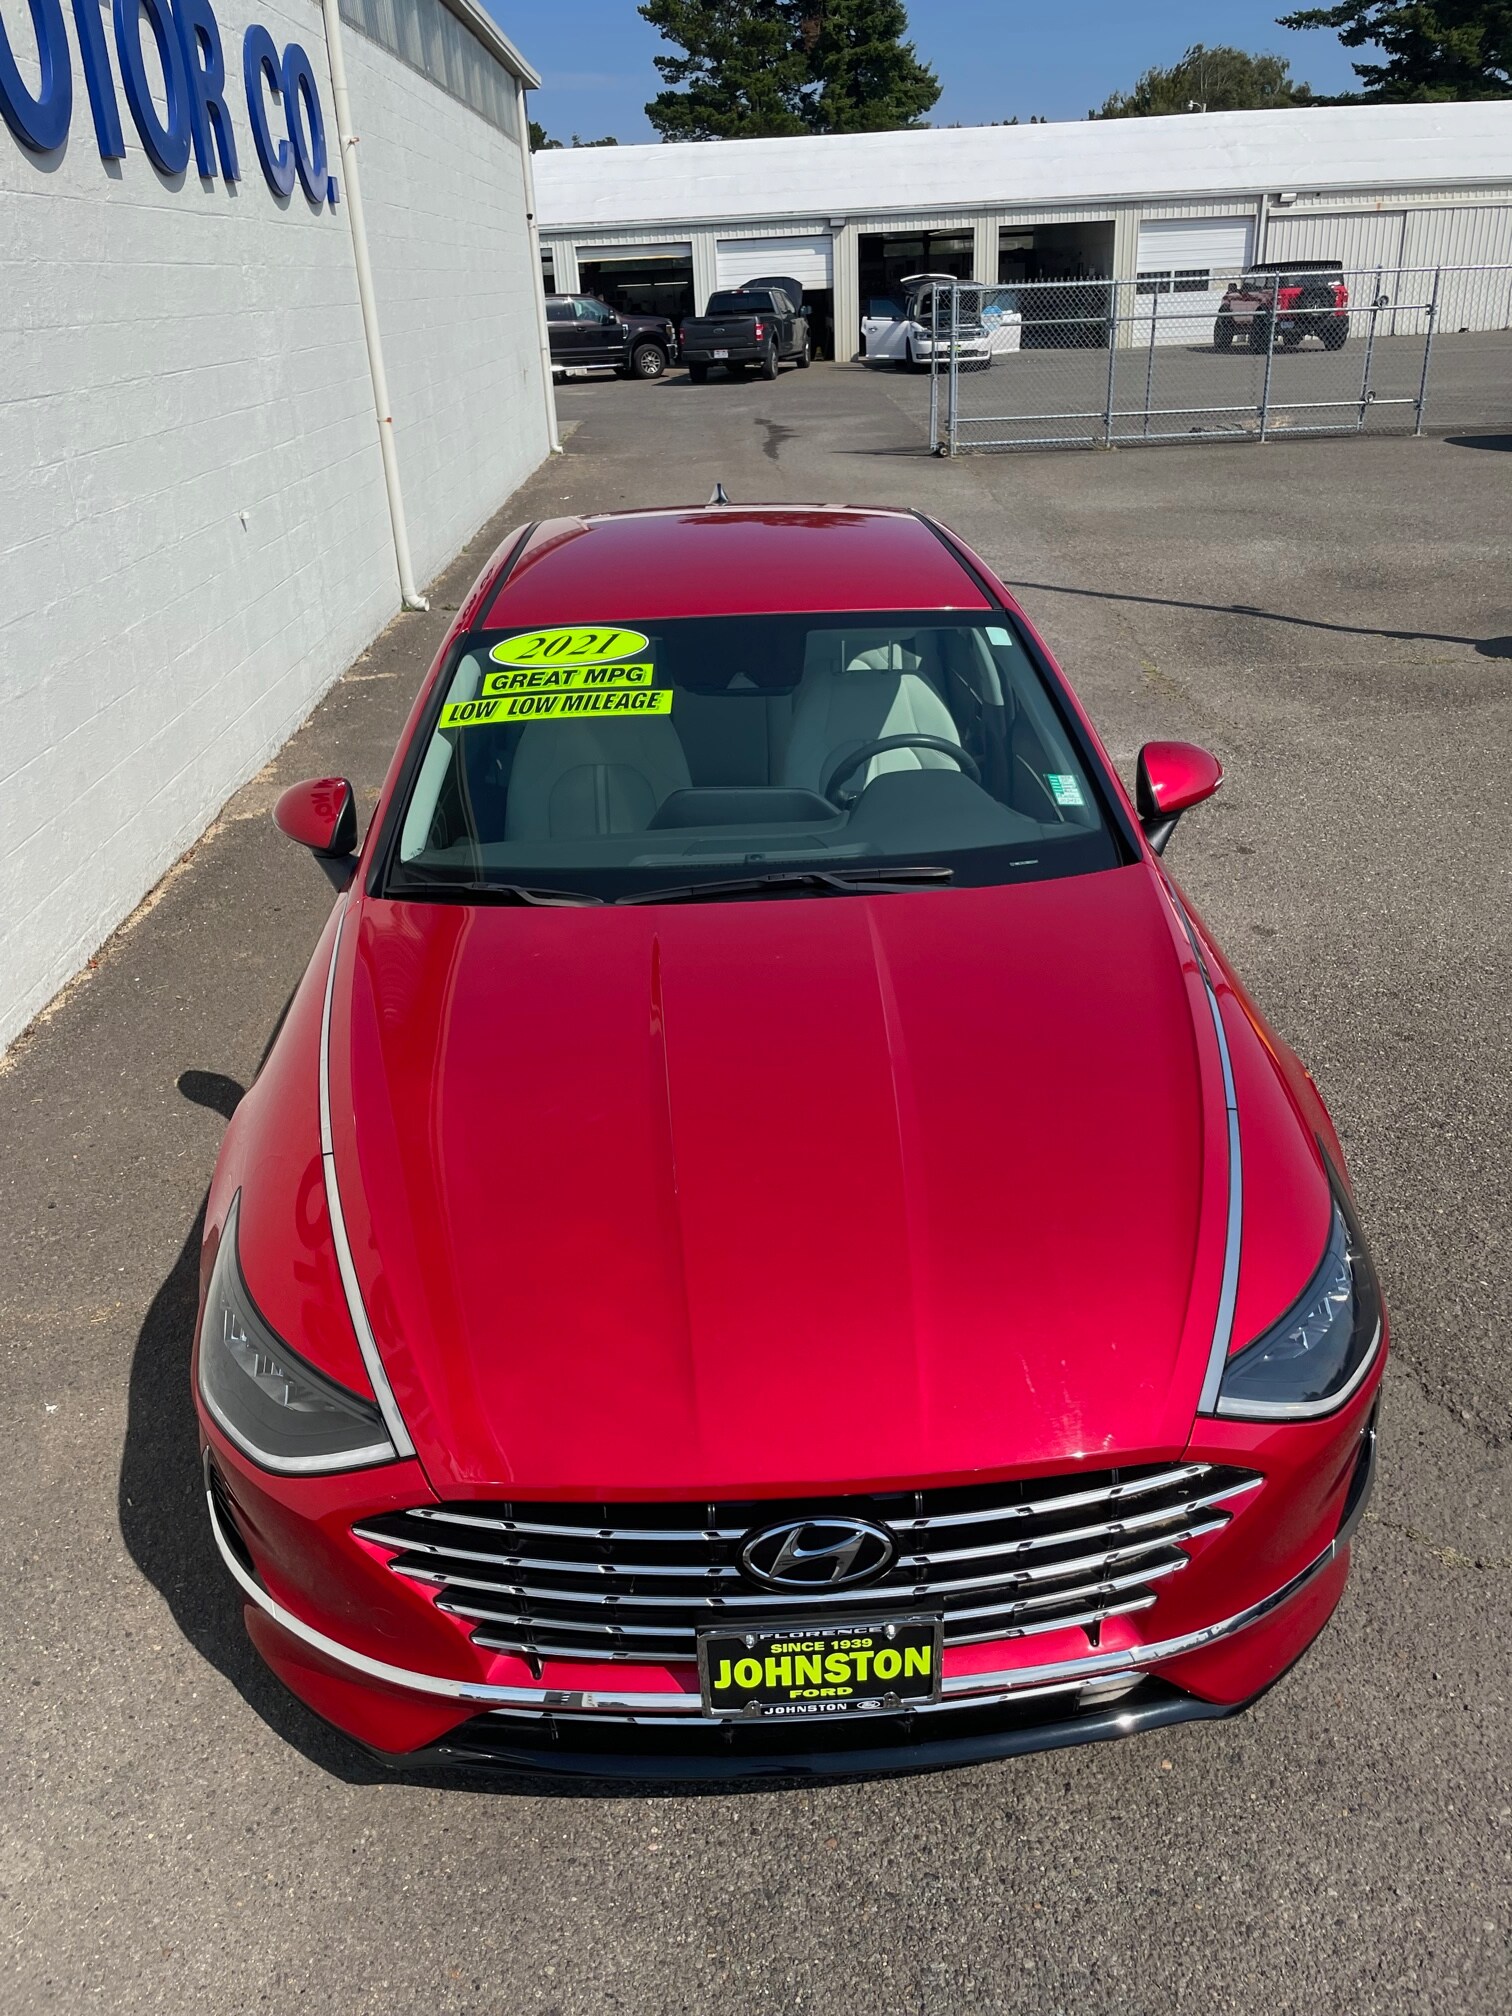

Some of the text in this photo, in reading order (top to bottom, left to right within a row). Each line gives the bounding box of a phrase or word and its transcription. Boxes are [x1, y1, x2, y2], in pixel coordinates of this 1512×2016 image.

[243, 24, 340, 204] CO.
[514, 633, 621, 661] 2021
[491, 667, 645, 691] GREAT MPG
[448, 691, 661, 722] LOW LOW MILEAGE
[760, 1626, 884, 1640] FLORENCE
[770, 1638, 873, 1654] SINCE 1939
[714, 1645, 931, 1689] JOHNSTON
[789, 1686, 853, 1699] FORD
[764, 1702, 848, 1715] JOHNSTON
